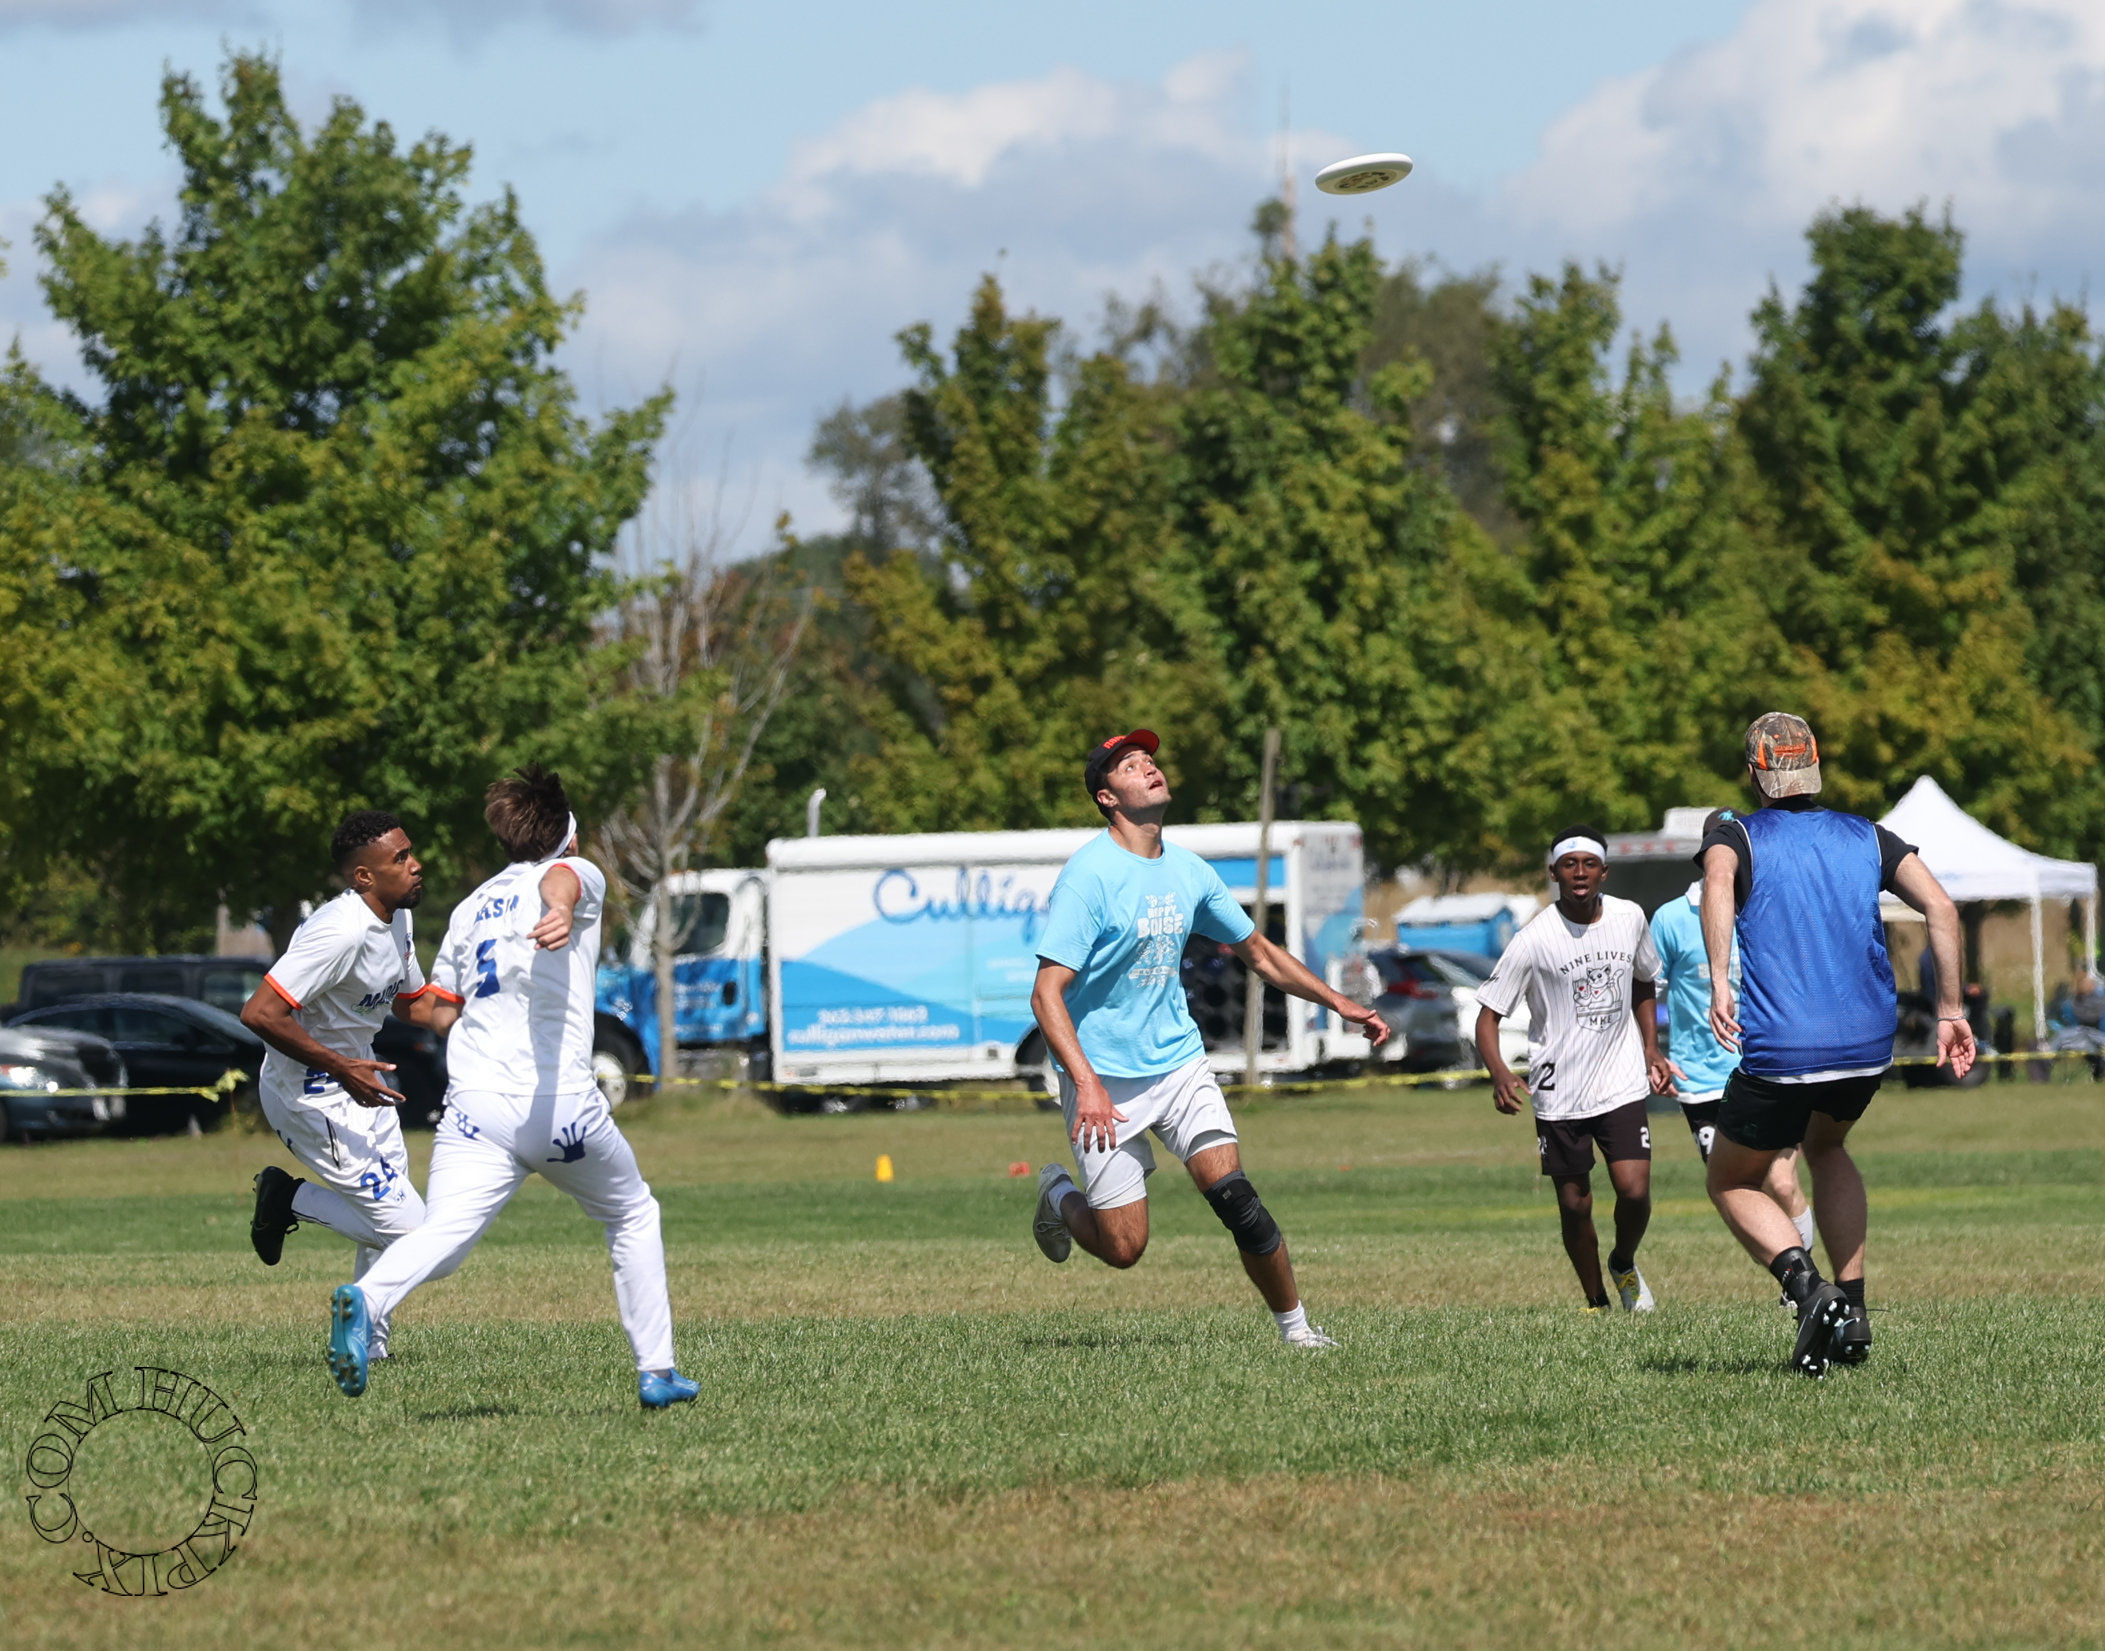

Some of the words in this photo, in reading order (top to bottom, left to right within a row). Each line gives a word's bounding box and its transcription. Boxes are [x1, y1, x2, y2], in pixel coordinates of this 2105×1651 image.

[1137, 914, 1184, 938] BOISE
[475, 938, 501, 999] 5
[1559, 953, 1591, 975] NINE
[1596, 950, 1633, 964] LIVES
[1589, 1014, 1612, 1026] MKE
[1538, 1062, 1556, 1091] 2
[1700, 1126, 1716, 1155] 9
